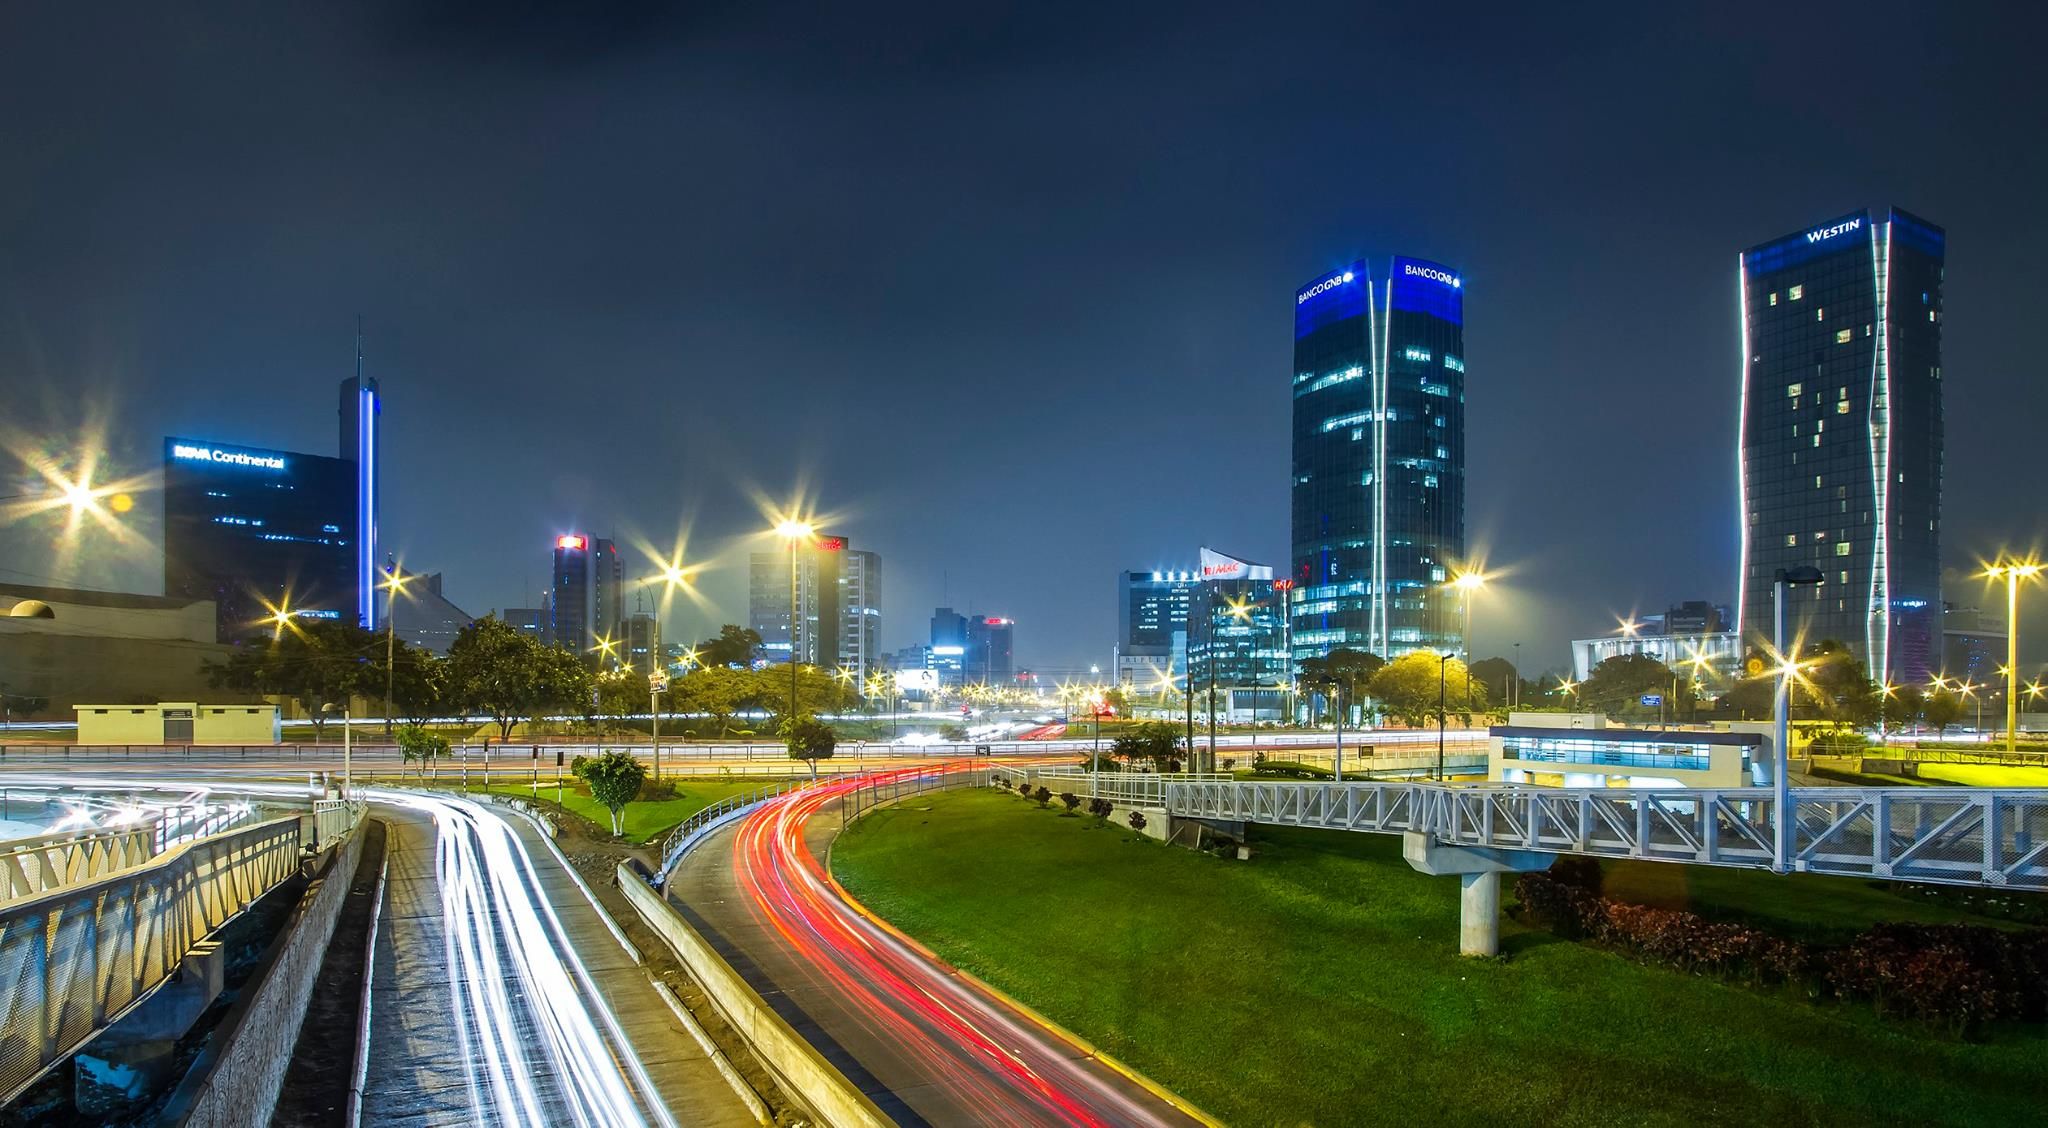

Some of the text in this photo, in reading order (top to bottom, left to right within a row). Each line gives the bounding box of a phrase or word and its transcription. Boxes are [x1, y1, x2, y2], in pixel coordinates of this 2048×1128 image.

[1807, 218, 1860, 243] WESTIN
[1405, 265, 1453, 285] BANCO GNB
[1298, 275, 1342, 305] BANCO GNB
[212, 450, 284, 469] Continental
